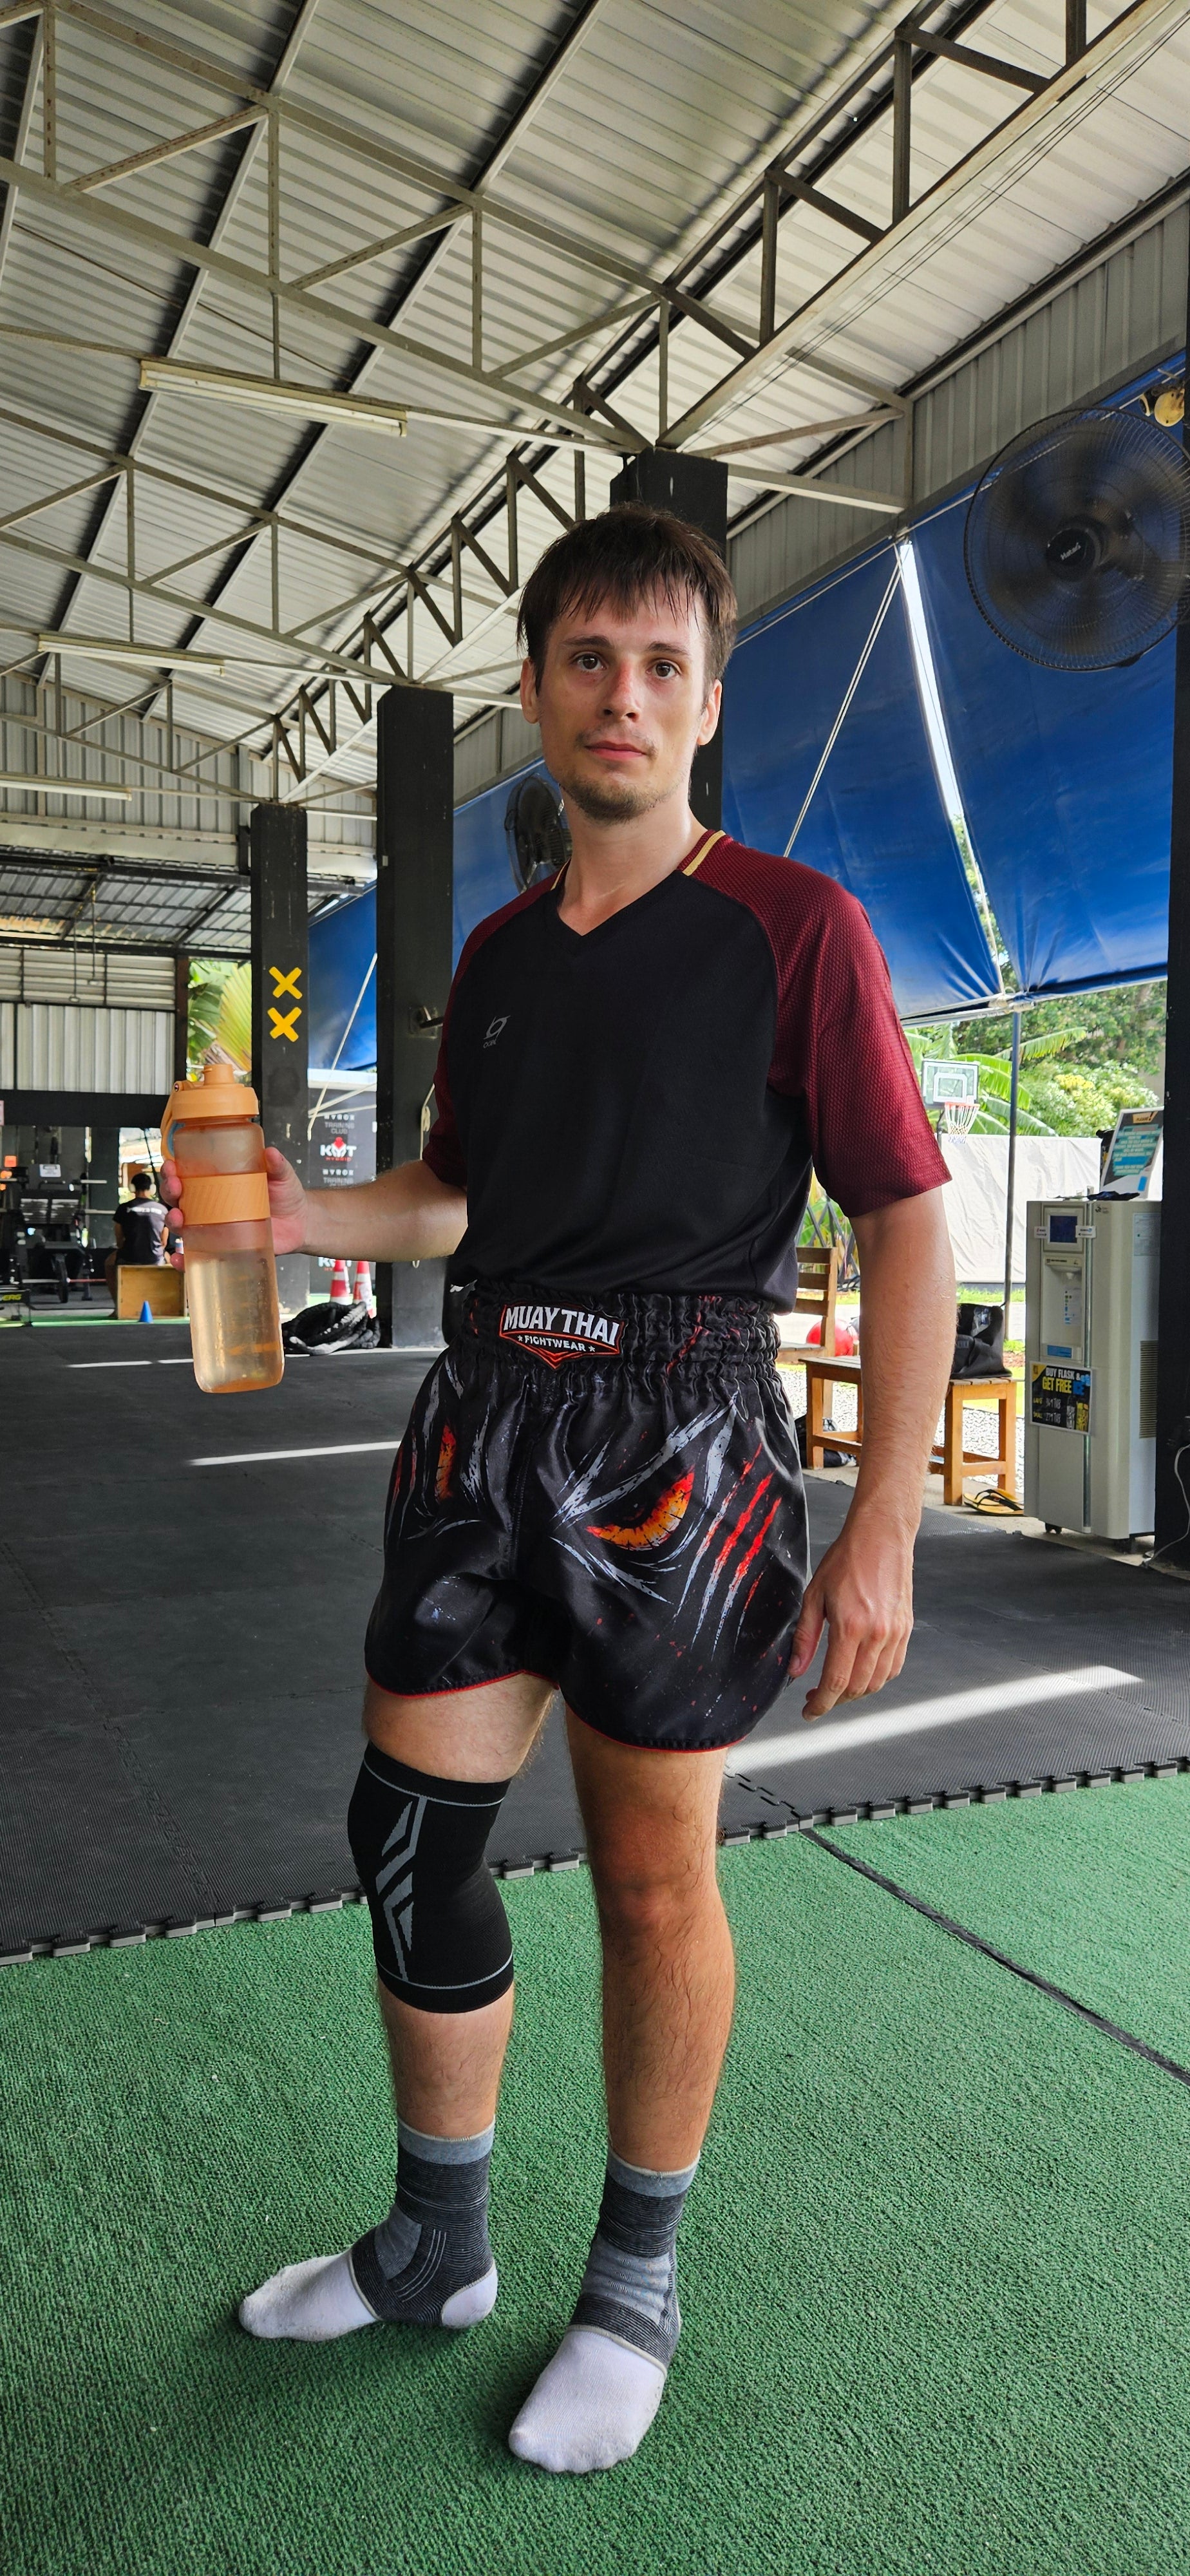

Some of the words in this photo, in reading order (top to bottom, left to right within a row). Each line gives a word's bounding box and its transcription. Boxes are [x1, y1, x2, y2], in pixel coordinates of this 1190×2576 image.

[504, 1305, 560, 1331] MUAY
[562, 1309, 619, 1346] THAI
[525, 1335, 586, 1351] FIGHTWEAR
[1045, 1367, 1057, 1378] BUY
[1058, 1368, 1075, 1380] FLASK
[1042, 1376, 1054, 1391] GET
[1055, 1378, 1072, 1394] FREE
